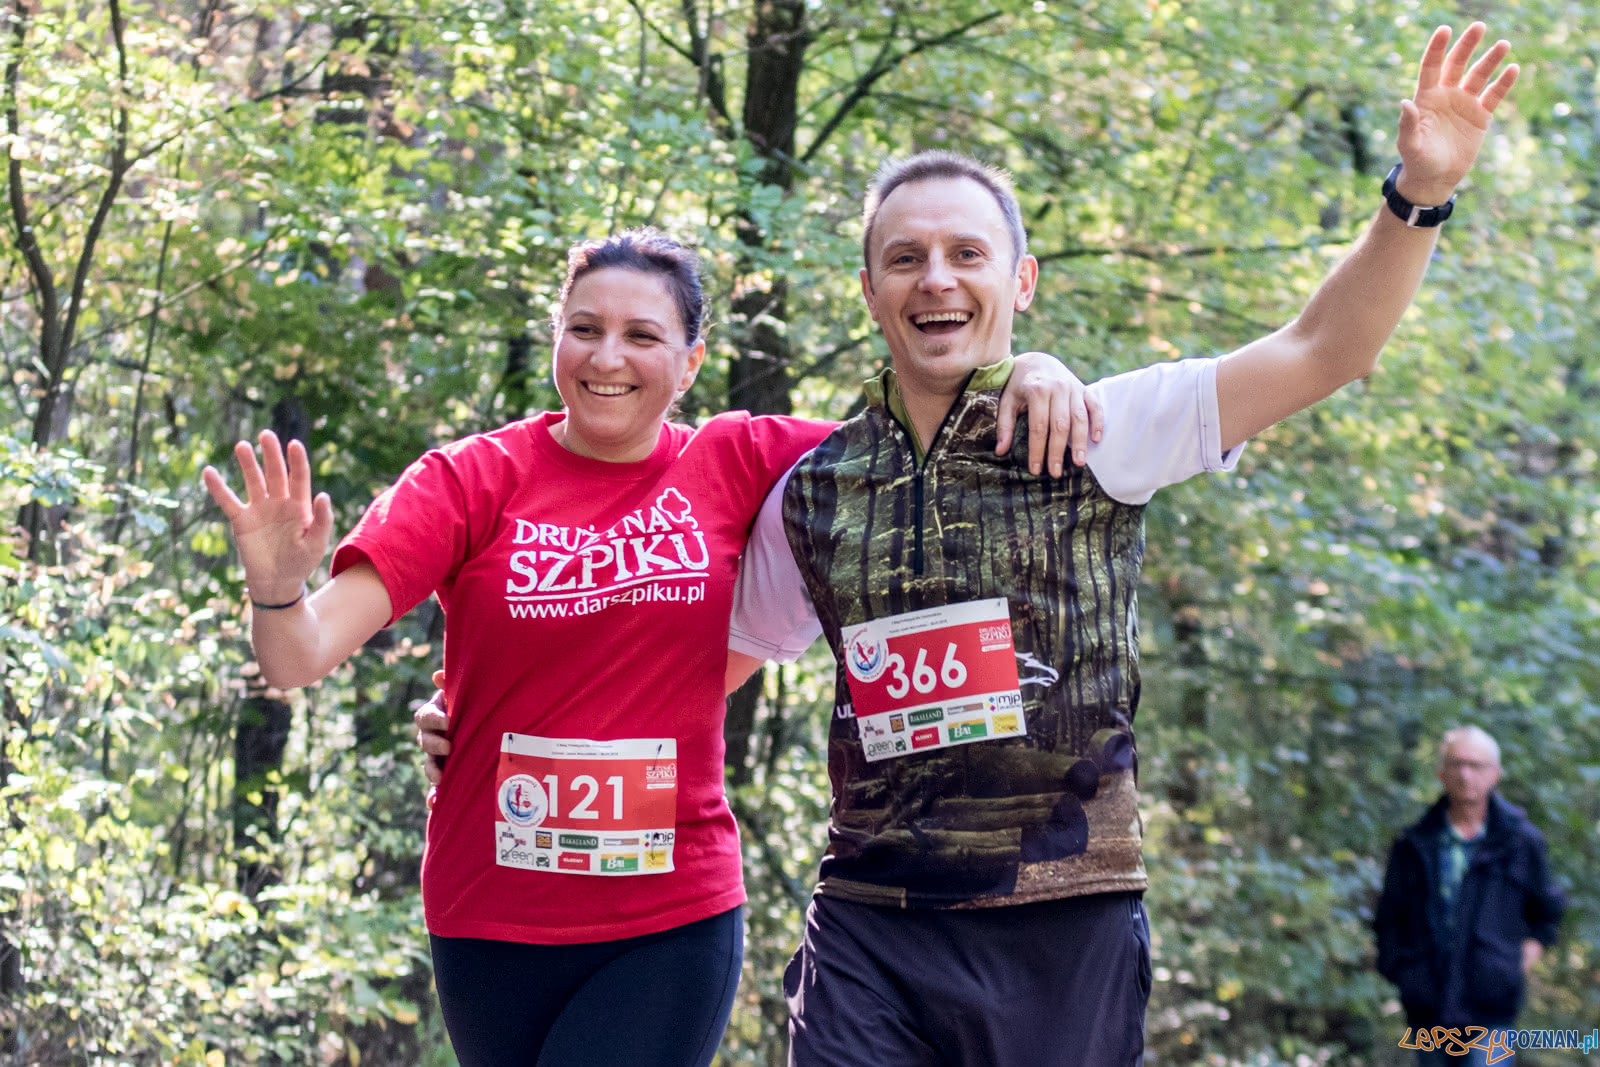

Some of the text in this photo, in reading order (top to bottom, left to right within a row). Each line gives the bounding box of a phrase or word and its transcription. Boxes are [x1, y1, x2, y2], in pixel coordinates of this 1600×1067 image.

[506, 531, 710, 594] SZPIKU
[508, 582, 705, 619] www.darszpiku.pl
[886, 642, 968, 699] 366
[542, 774, 623, 820] 121
